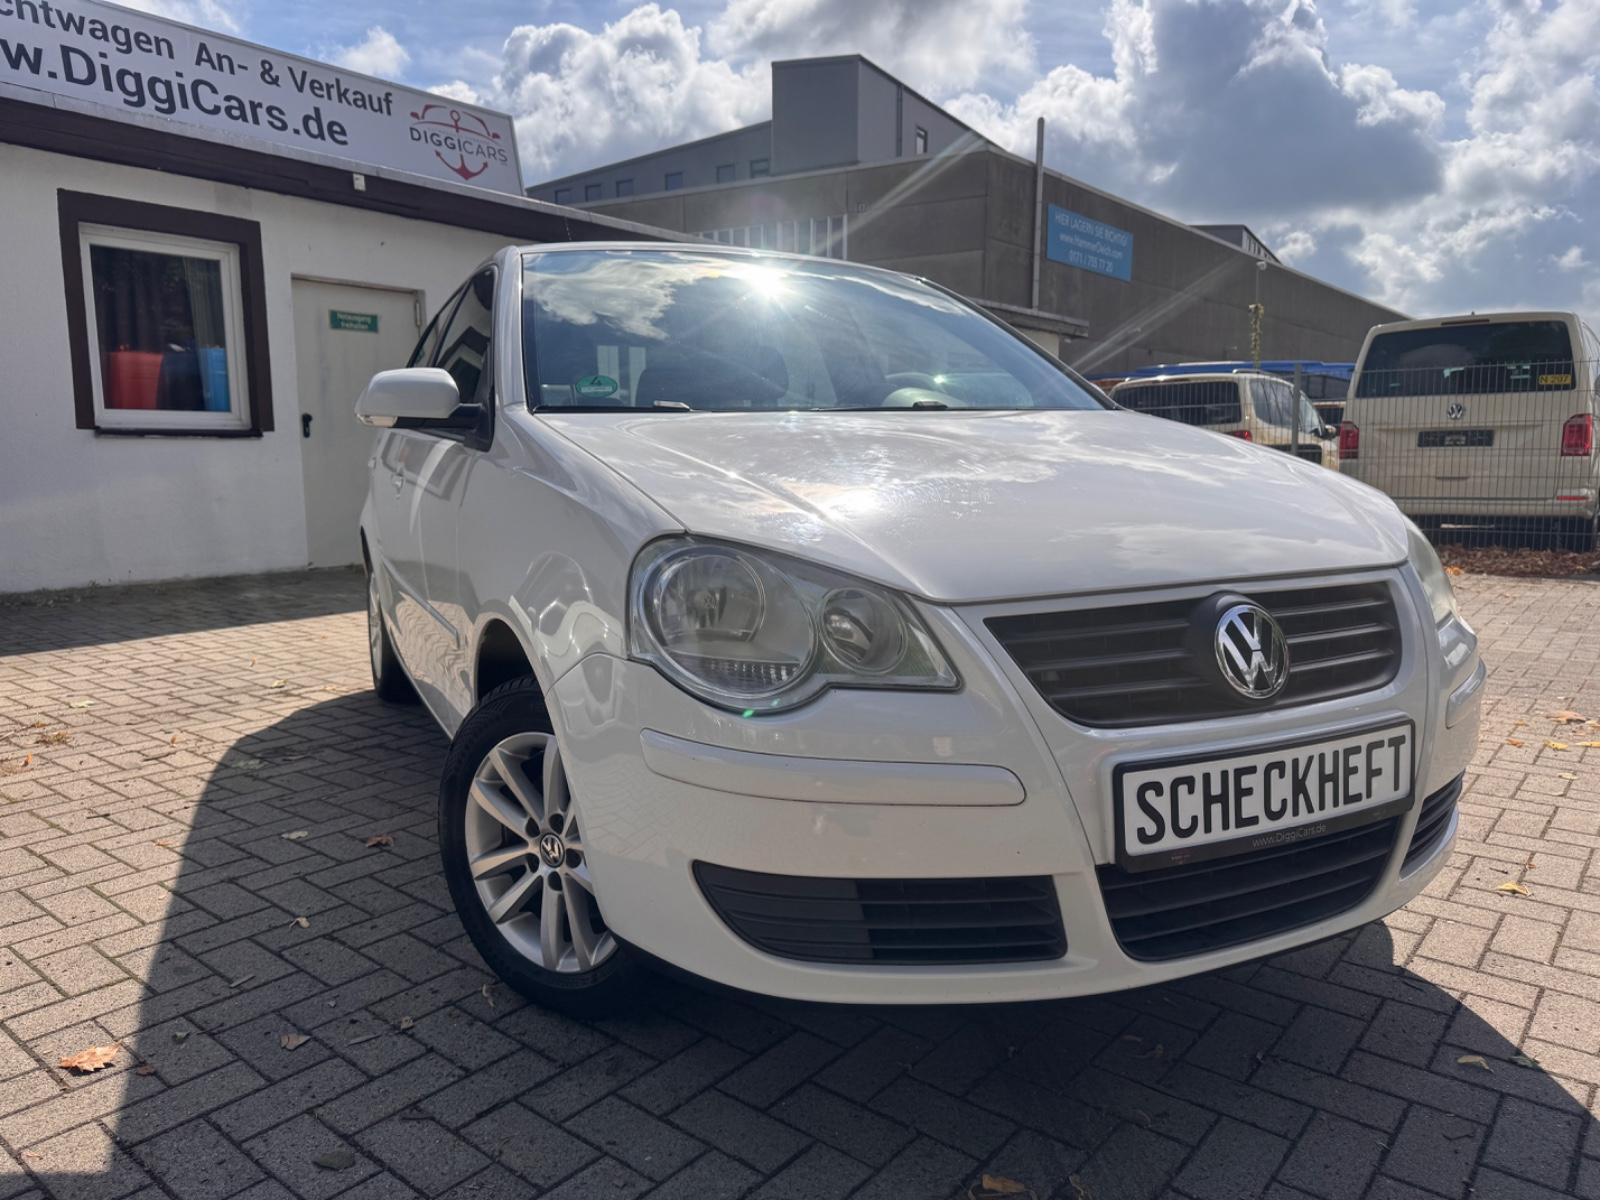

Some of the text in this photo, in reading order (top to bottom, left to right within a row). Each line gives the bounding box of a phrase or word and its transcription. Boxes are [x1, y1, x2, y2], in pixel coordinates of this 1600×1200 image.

[195, 42, 249, 76] An-
[259, 59, 281, 87] &
[287, 65, 394, 117] Verkauf
[409, 127, 508, 163] DIGGICARS
[1136, 734, 1406, 845] SCHECKHEFT
